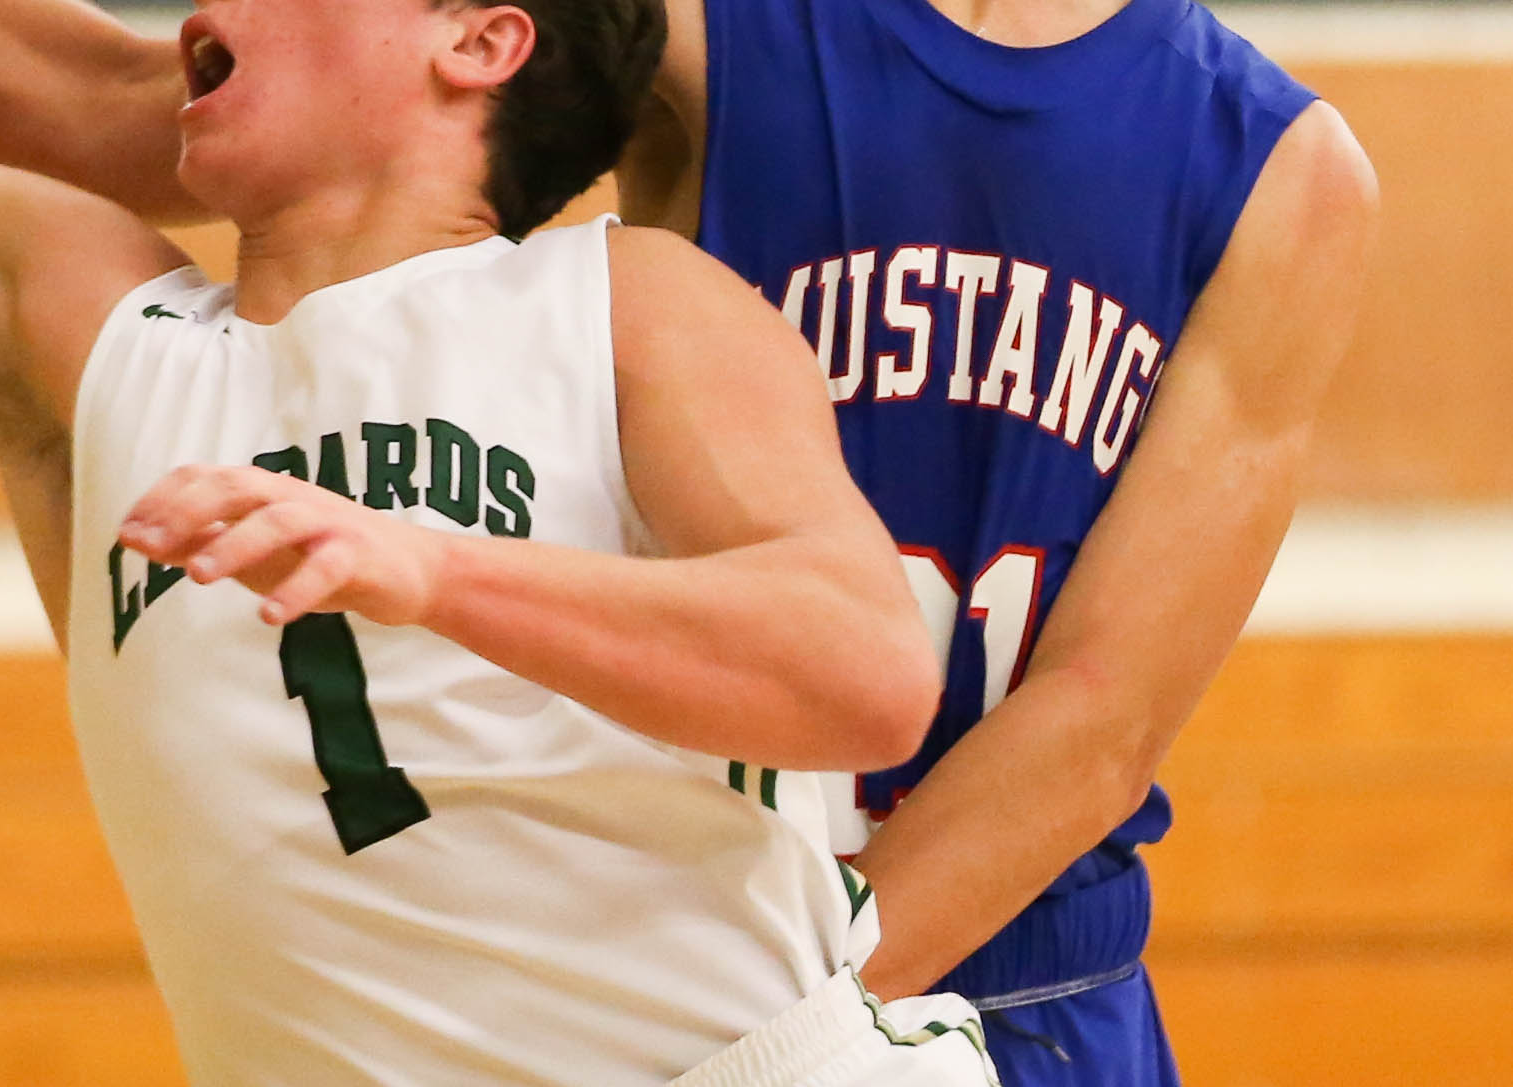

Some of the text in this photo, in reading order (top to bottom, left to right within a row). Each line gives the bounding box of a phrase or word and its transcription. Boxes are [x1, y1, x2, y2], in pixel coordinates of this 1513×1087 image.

[752, 243, 1167, 478] USTANG
[108, 417, 536, 658] LARDS
[278, 611, 432, 857] 1
